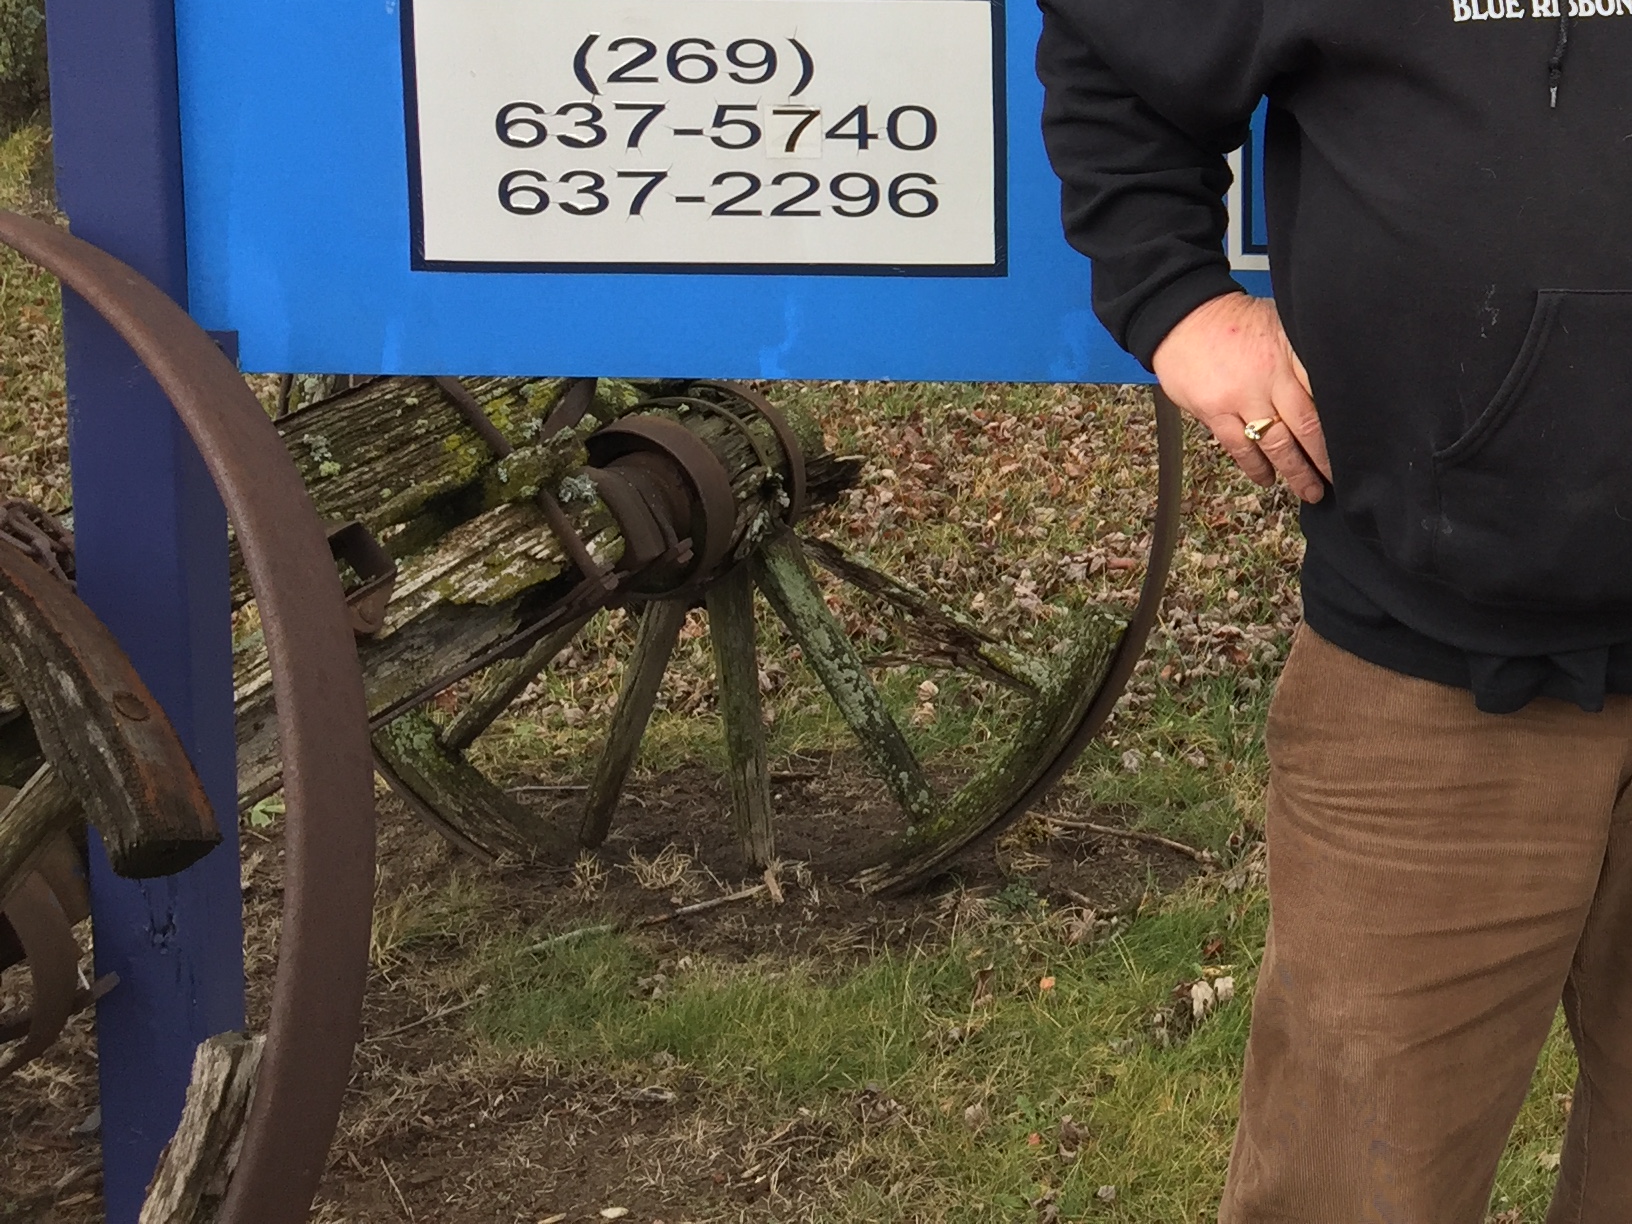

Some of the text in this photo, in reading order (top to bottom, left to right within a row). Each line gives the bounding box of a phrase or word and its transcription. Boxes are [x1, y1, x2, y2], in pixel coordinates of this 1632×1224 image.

[572, 33, 814, 97] (269)
[495, 101, 938, 153] 637-5740
[498, 169, 940, 218] 637-2296
